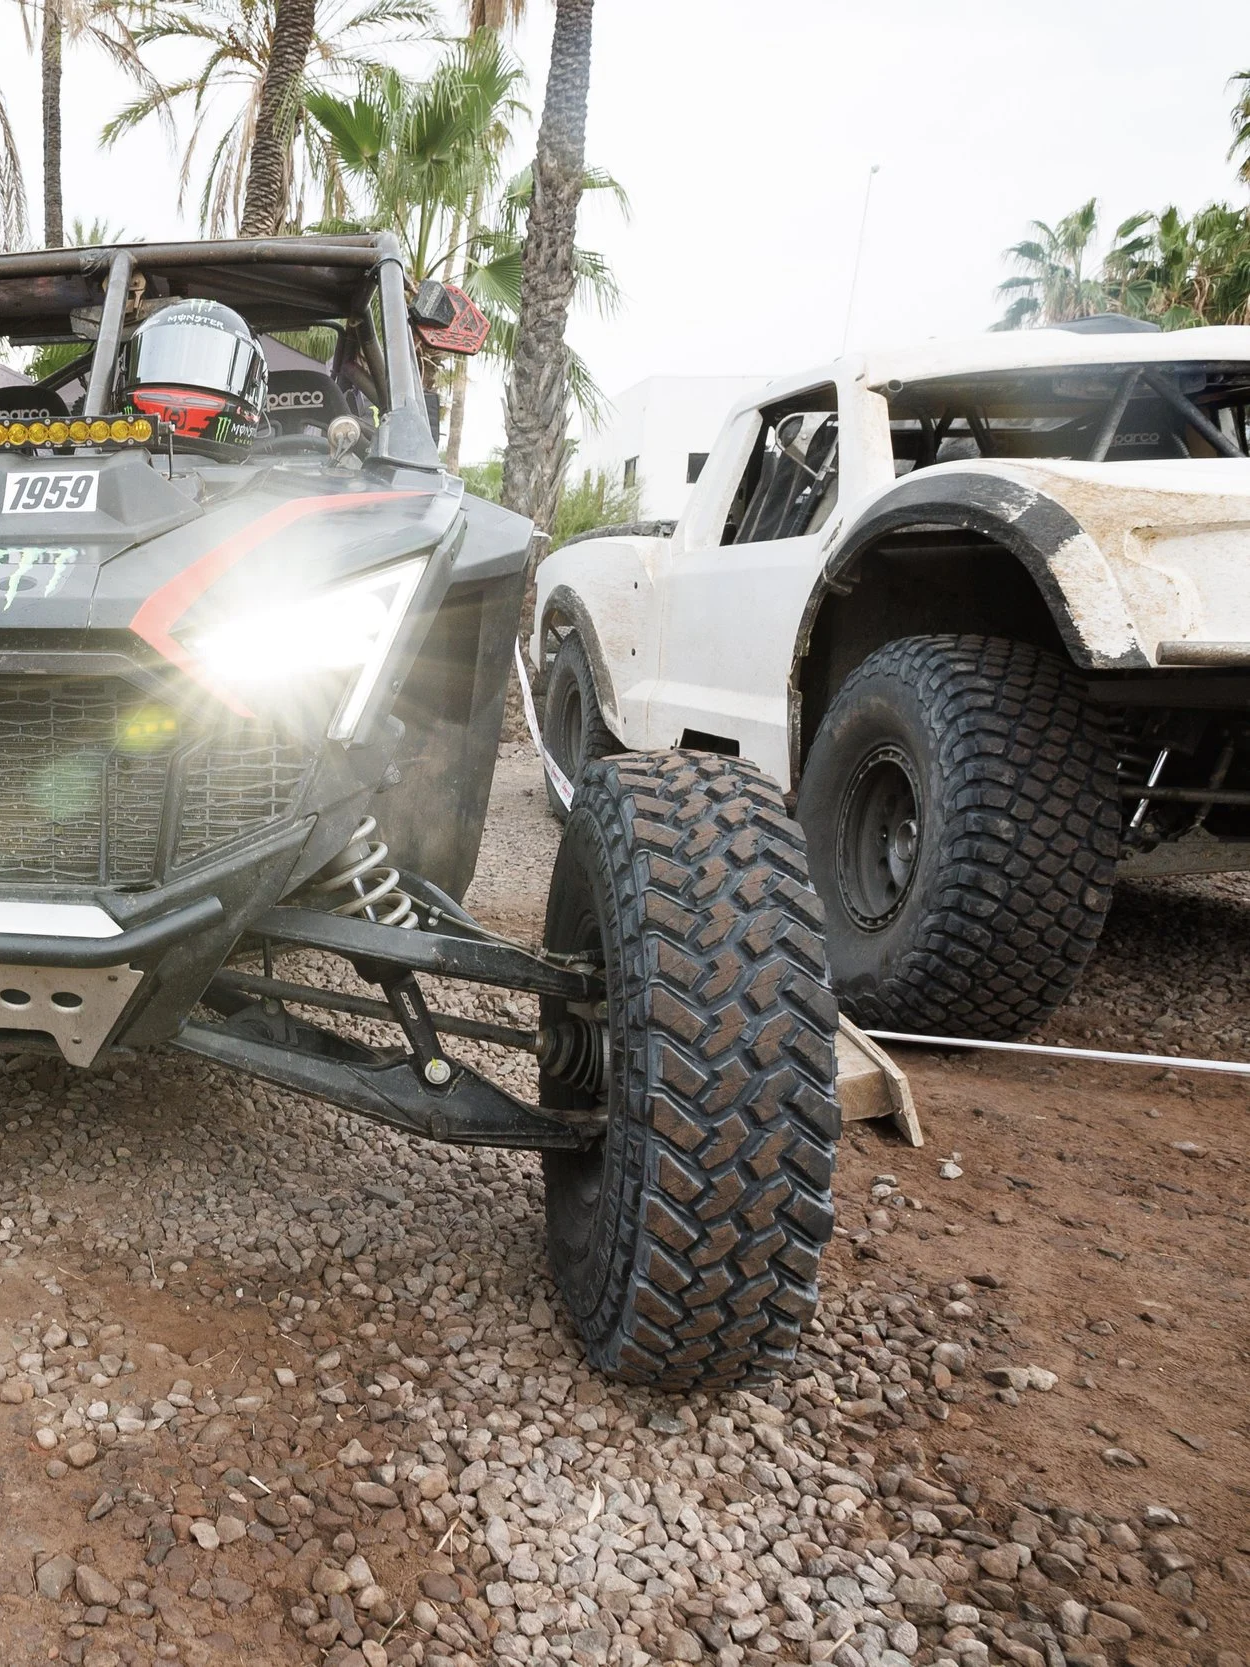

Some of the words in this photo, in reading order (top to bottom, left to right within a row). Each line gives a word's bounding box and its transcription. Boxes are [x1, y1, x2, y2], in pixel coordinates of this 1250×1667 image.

[266, 391, 324, 412] parco
[1113, 432, 1160, 447] parco
[9, 475, 95, 511] 1959
